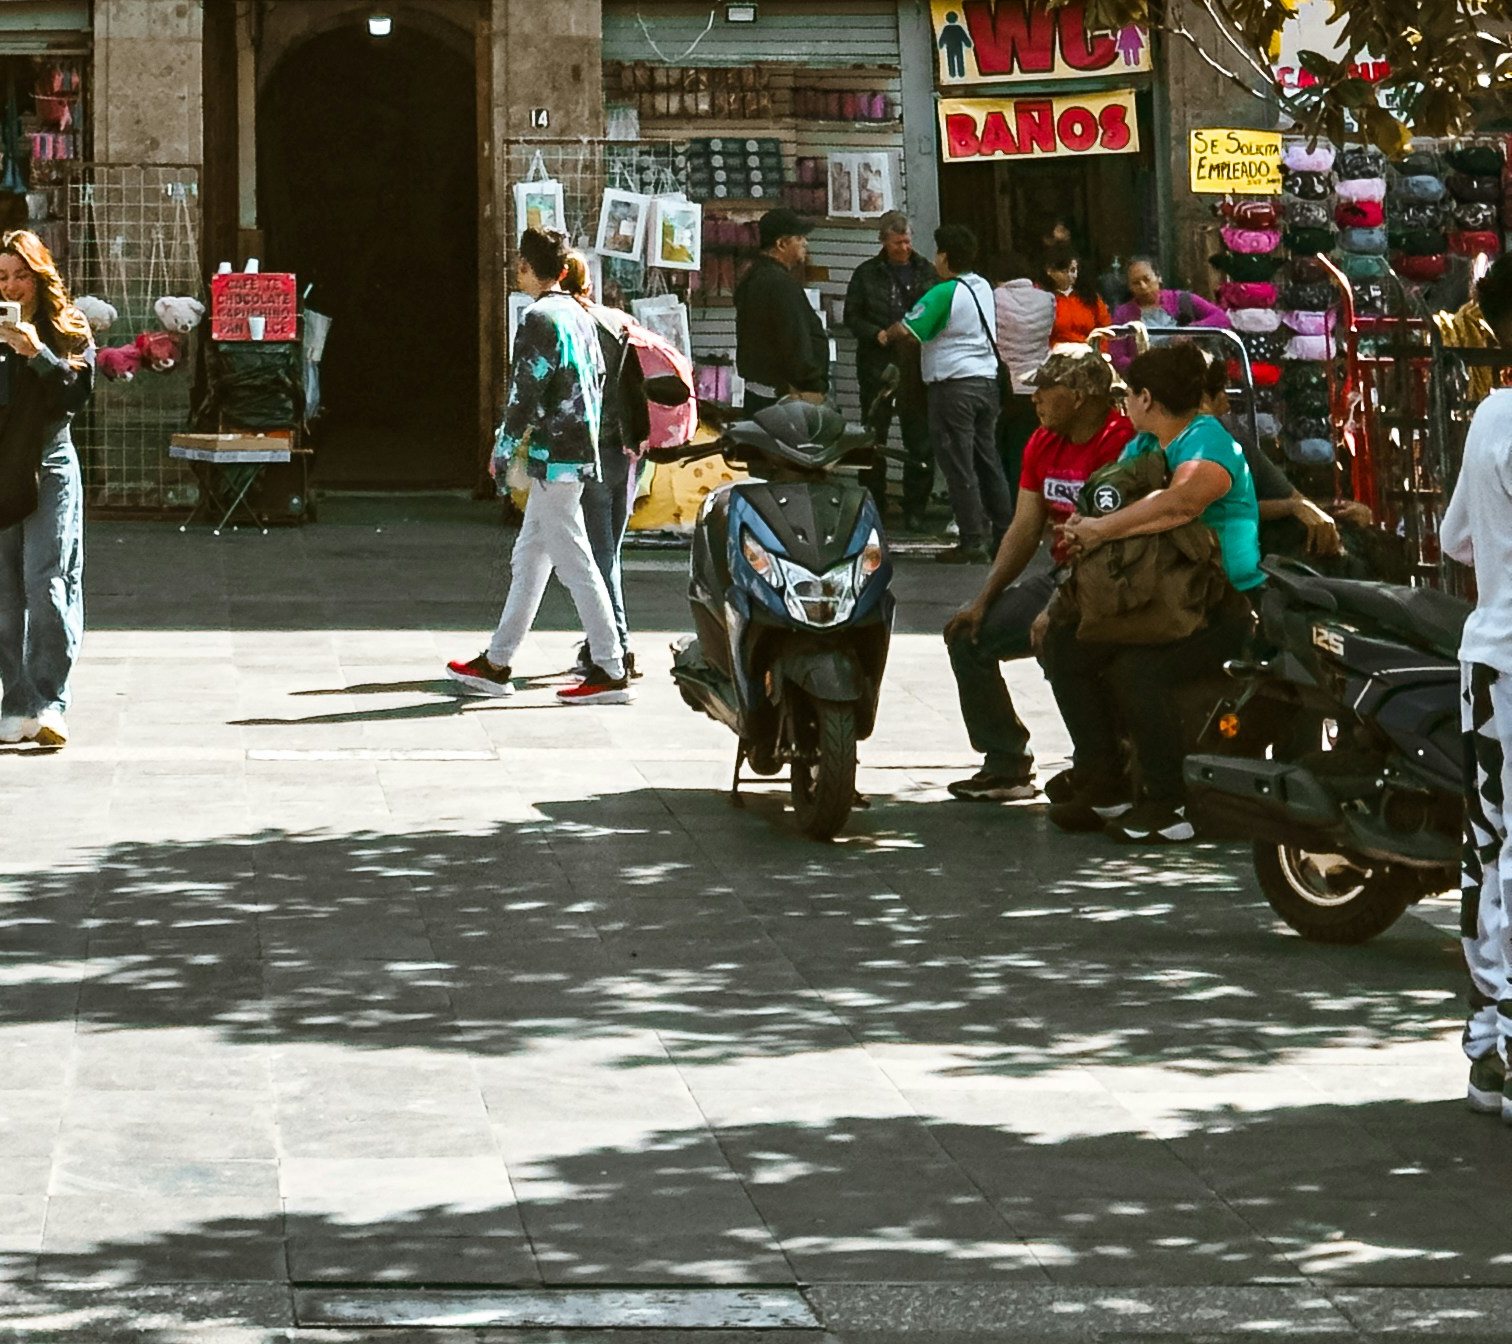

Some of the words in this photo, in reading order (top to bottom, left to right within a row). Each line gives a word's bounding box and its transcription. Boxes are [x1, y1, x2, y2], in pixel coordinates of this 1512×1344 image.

[531, 110, 548, 127] 14
[945, 99, 1131, 158] BAÑOS
[1196, 156, 1270, 180] EMPLEADO
[216, 293, 291, 305] CHOCOLATE
[1312, 625, 1345, 656] 125
